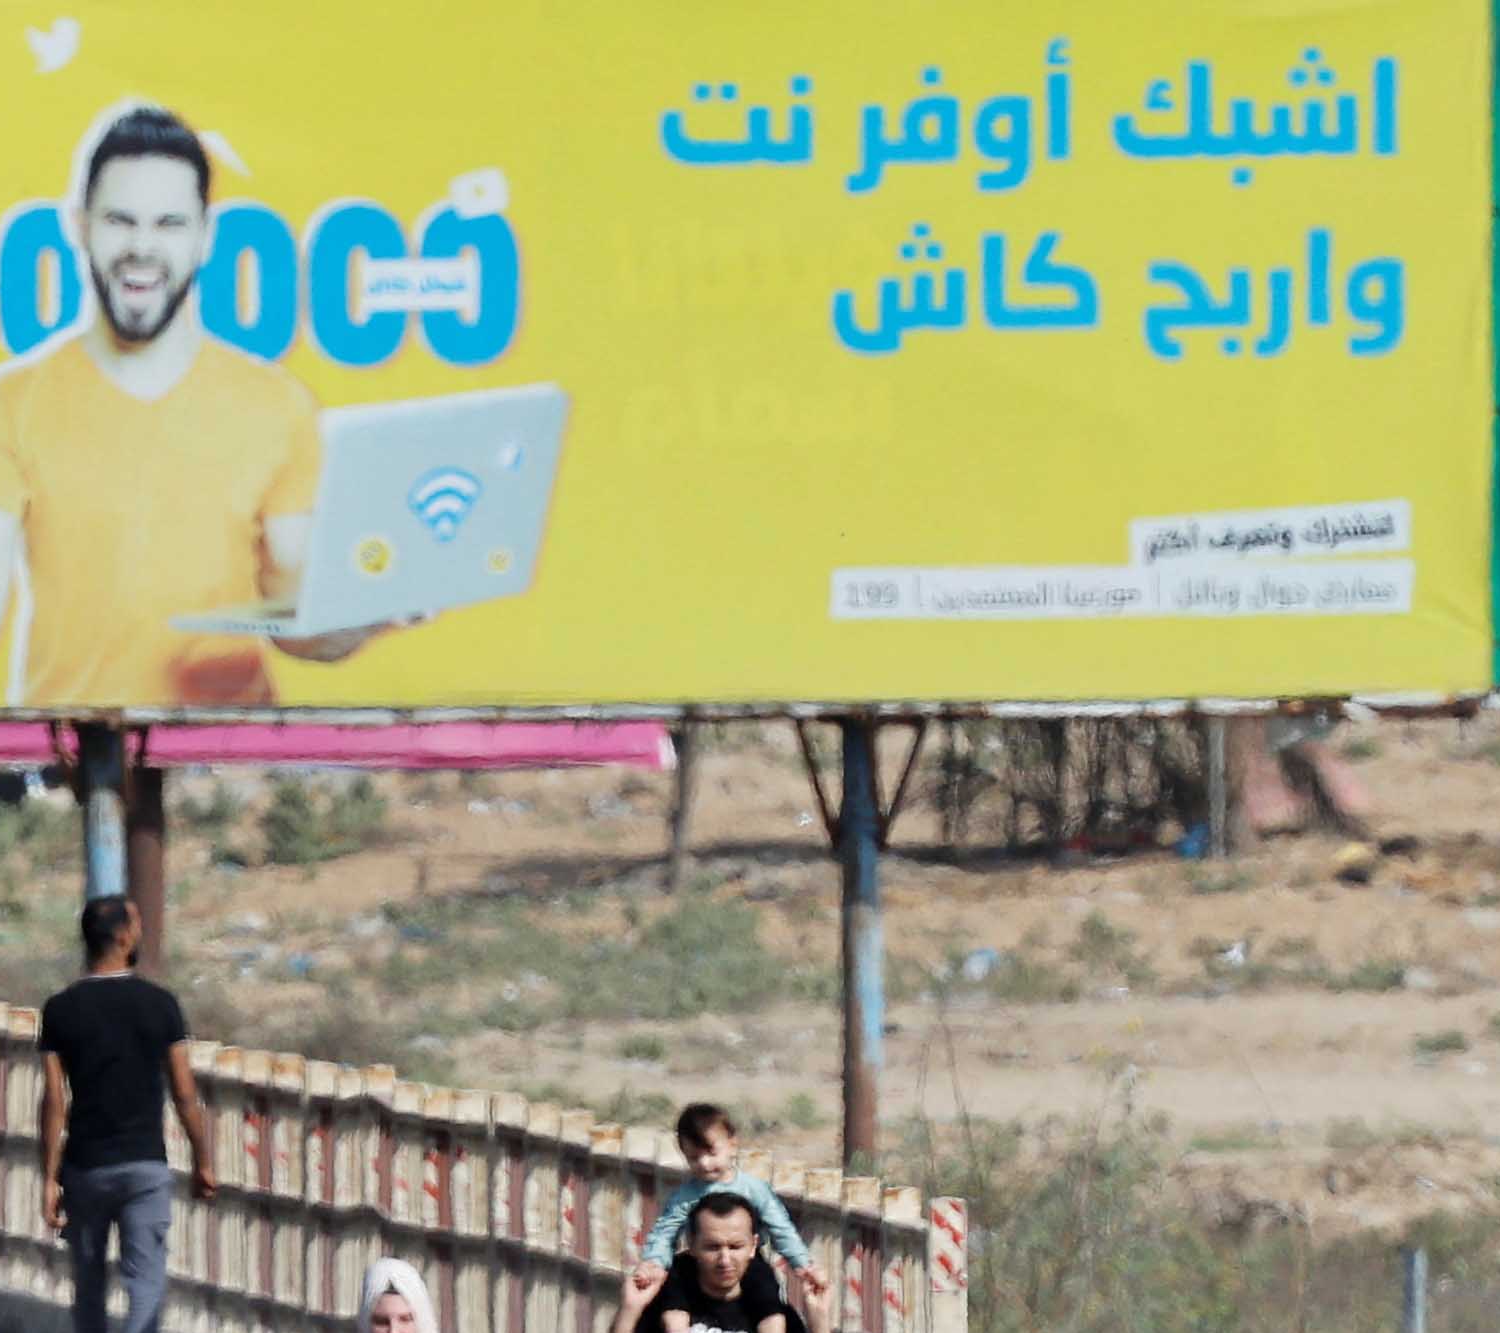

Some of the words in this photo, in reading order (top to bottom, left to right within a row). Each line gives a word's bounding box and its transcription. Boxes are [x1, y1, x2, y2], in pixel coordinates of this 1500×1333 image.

[661, 76, 813, 164] نت
[846, 38, 1069, 192] أوفر
[1113, 48, 1397, 185] اشبك
[833, 224, 1099, 353] كاش
[1145, 229, 1404, 358] واربح
